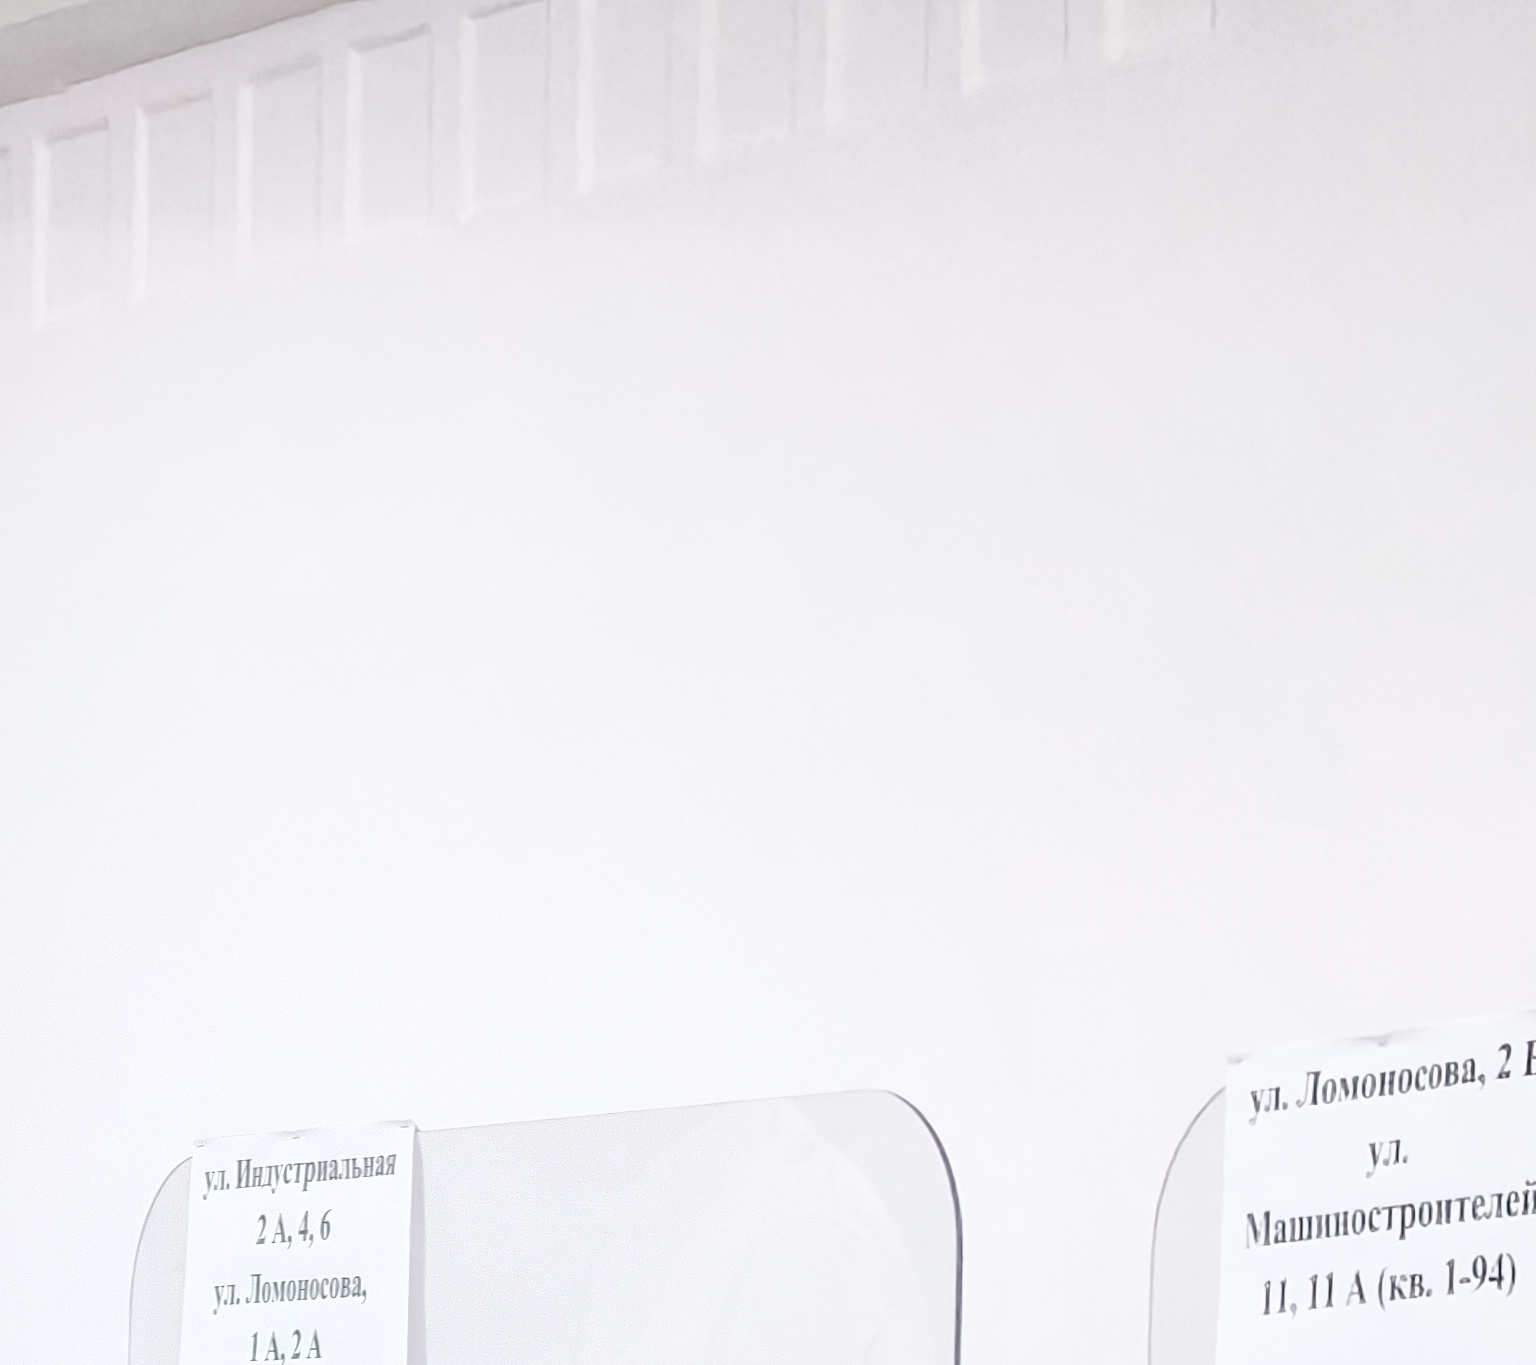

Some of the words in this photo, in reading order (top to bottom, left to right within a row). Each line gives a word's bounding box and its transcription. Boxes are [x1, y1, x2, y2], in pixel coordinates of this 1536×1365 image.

[1248, 1085, 1289, 1126] ул.
[1295, 1056, 1487, 1107] Ломоносова,
[1496, 1042, 1512, 1080] 2
[202, 1169, 230, 1200] ул.
[234, 1153, 398, 1195] Индустриальная
[1365, 1137, 1409, 1179] ул.
[255, 1213, 267, 1246] 2
[270, 1212, 293, 1250] А,
[297, 1209, 315, 1249] 4,
[319, 1208, 333, 1241] 6
[1245, 1179, 1536, 1249] Машиностроителей
[212, 1284, 241, 1316] ул.
[245, 1273, 368, 1305] Ломоносова,
[1263, 1276, 1298, 1321] 11,
[1308, 1270, 1335, 1311] 11
[1346, 1268, 1367, 1307] А
[1377, 1266, 1433, 1312] (кв.
[1445, 1252, 1517, 1298] 1-94)
[249, 1331, 259, 1363] 1
[290, 1328, 302, 1360] 2
[306, 1328, 323, 1360] А
